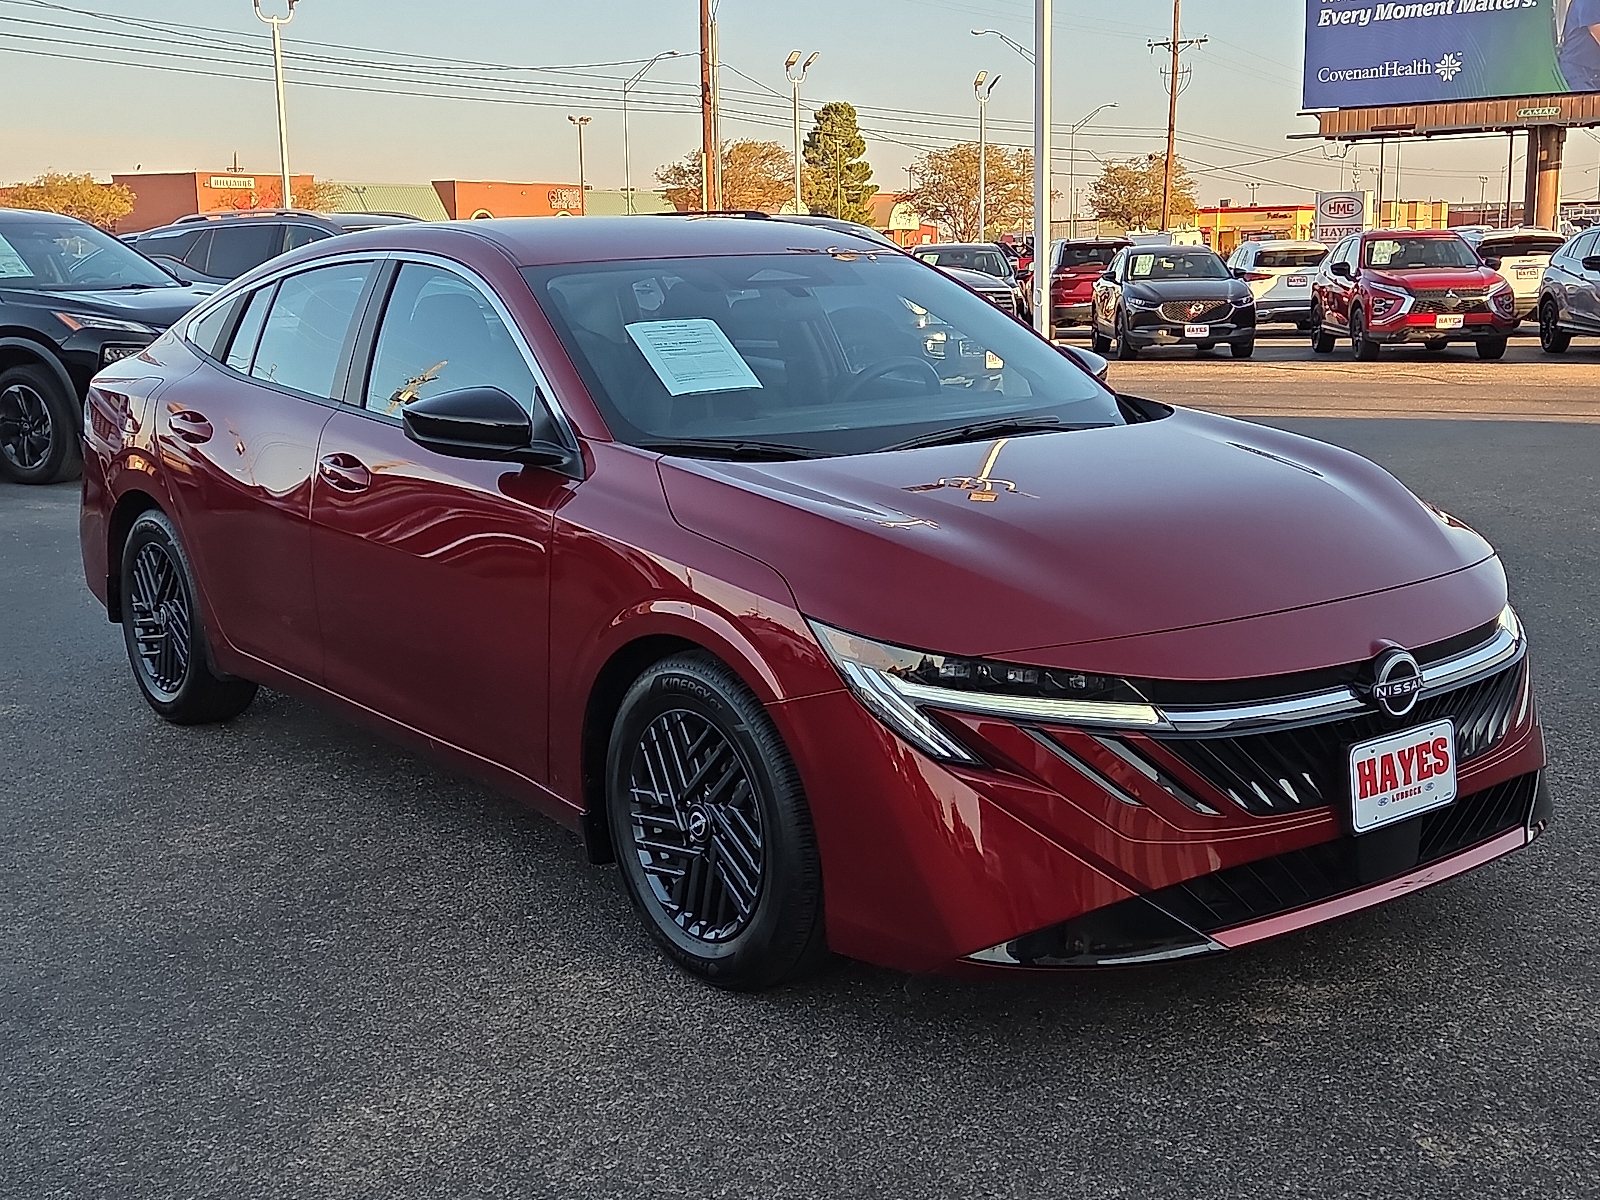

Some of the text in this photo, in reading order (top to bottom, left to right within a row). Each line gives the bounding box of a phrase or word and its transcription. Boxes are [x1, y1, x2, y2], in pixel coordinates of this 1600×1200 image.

[1317, 8, 1372, 26] Every
[1373, 0, 1455, 21] Moment
[1318, 59, 1432, 82] CovenantHealth
[1520, 107, 1558, 116] LAMAR
[1328, 200, 1355, 215] HMC
[1320, 227, 1362, 237] HAYES
[1376, 679, 1423, 698] NISSAN
[1357, 738, 1448, 799] HAYES
